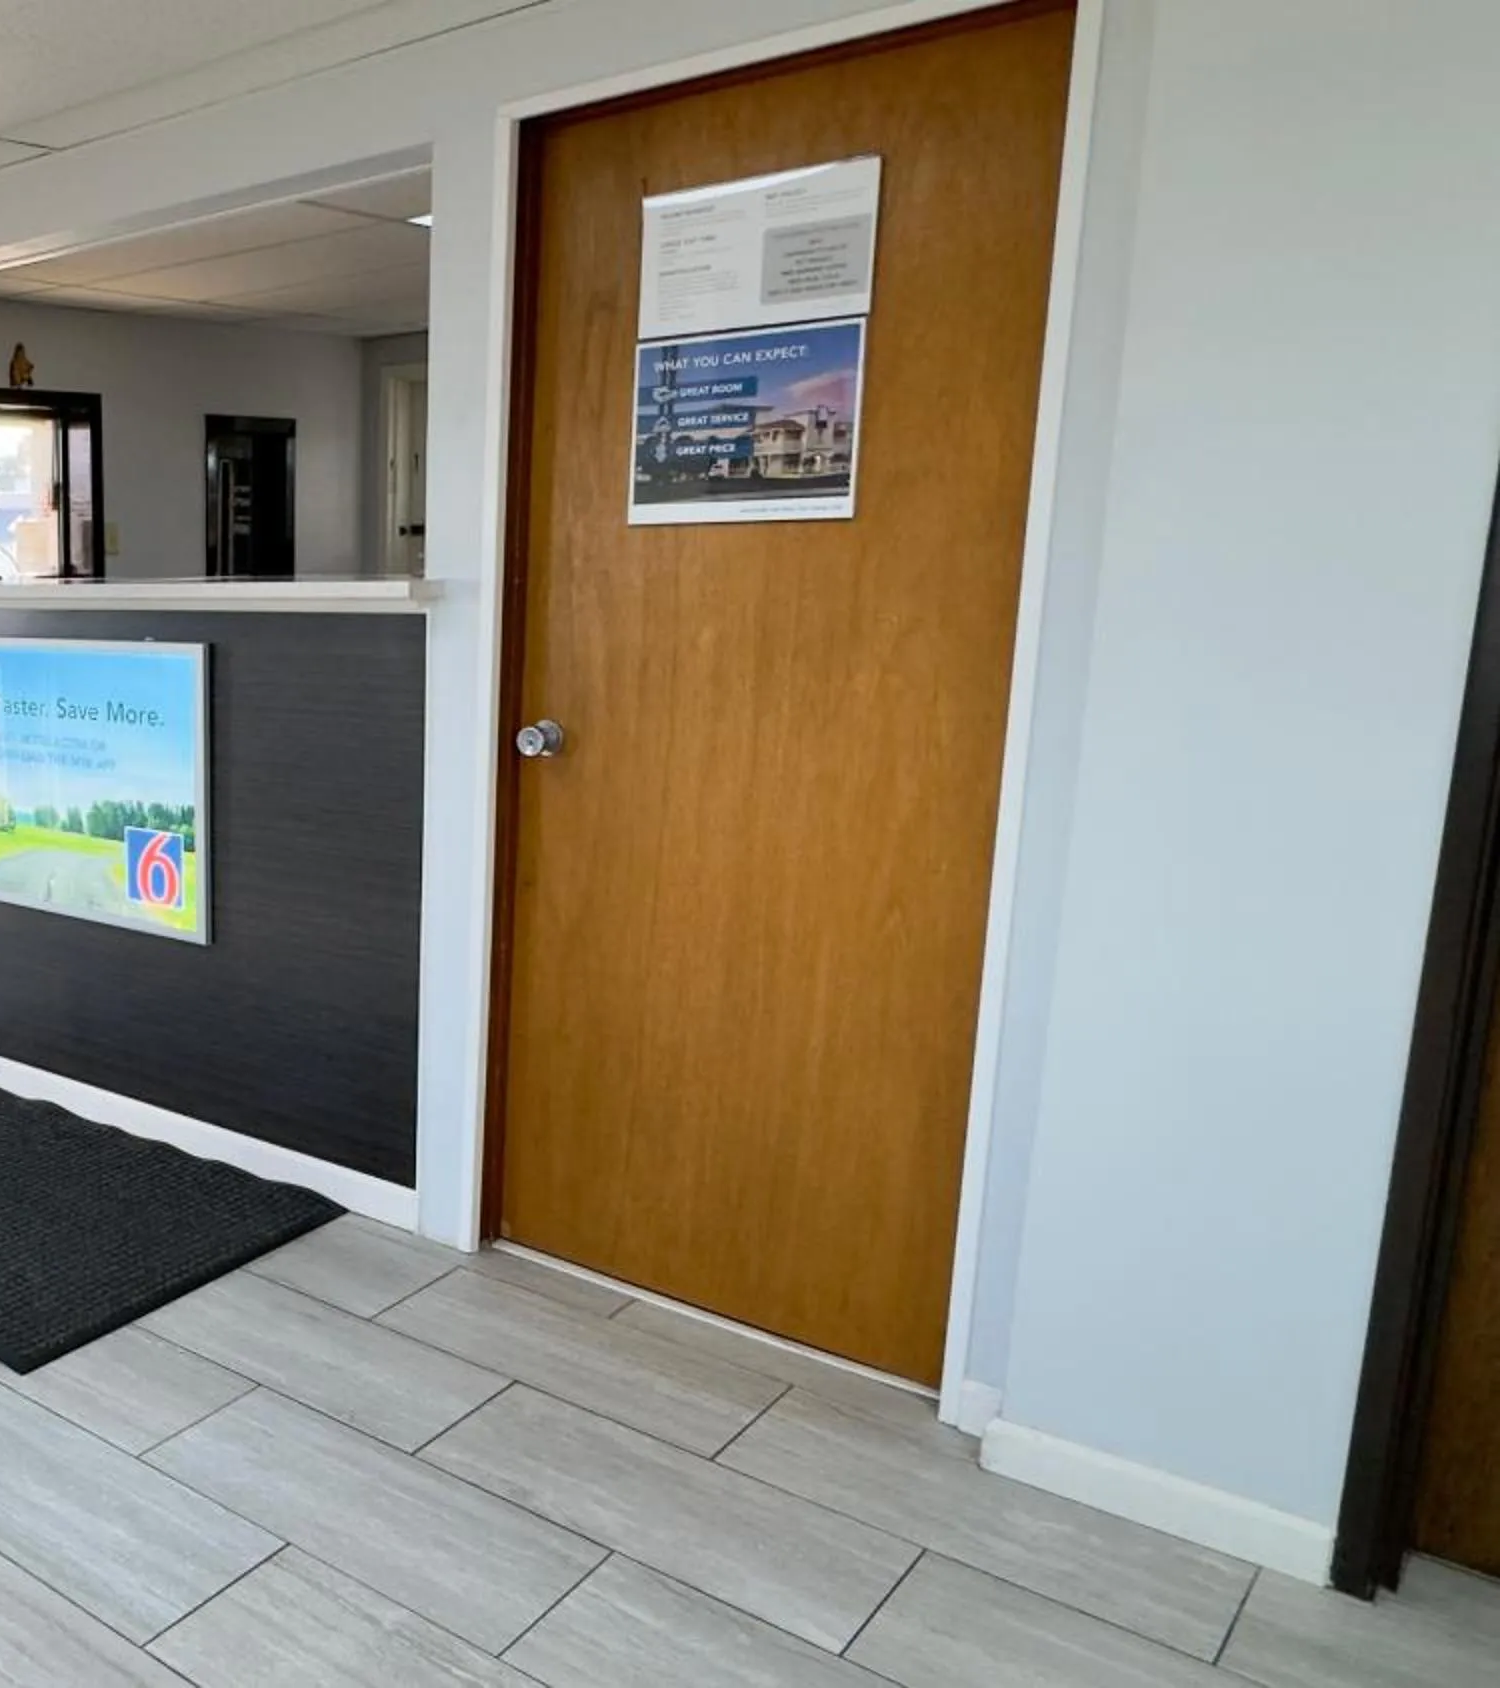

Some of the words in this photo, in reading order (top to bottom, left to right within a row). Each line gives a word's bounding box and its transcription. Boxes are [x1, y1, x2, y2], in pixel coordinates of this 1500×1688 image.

[653, 358, 688, 373] WHAT
[694, 355, 719, 368] YOU
[723, 351, 750, 365] CAN
[679, 386, 710, 398] GREAT
[712, 382, 743, 395] ROOM
[677, 415, 708, 427] GREAT
[710, 412, 749, 424] SERVICE
[675, 445, 707, 457] GREAT
[709, 442, 737, 455] PRICE
[56, 697, 99, 721] Save
[106, 700, 165, 727] More.
[137, 832, 179, 908] 6
